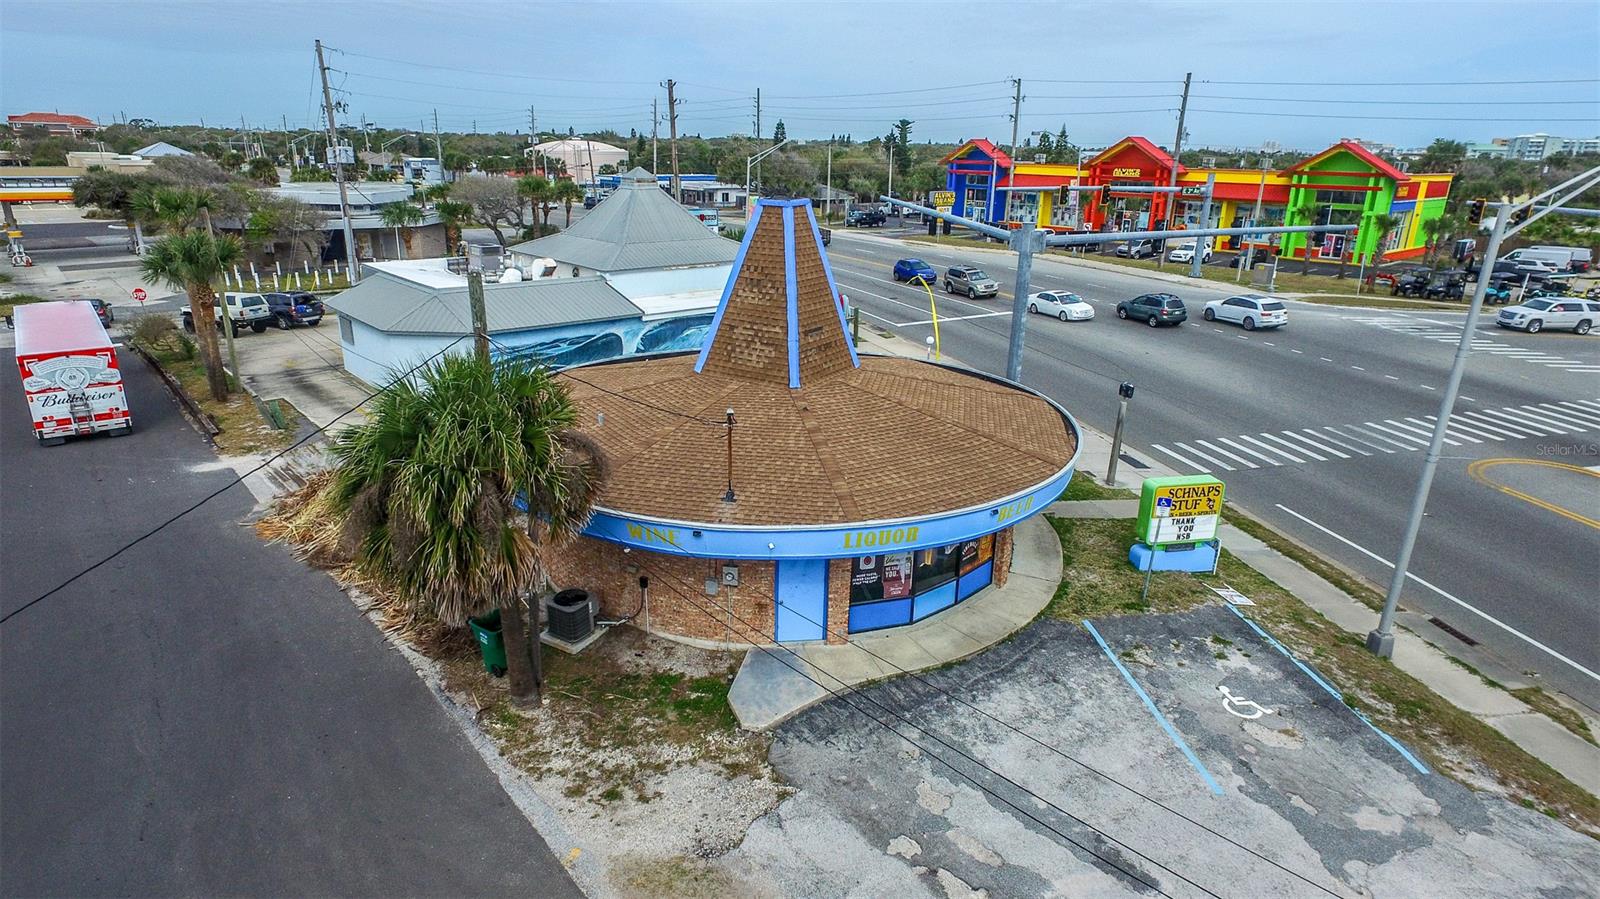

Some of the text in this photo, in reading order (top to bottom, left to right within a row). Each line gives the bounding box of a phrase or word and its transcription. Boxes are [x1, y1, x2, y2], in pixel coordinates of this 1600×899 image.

[37, 391, 115, 408] Budweiser
[1168, 486, 1221, 499] SCHNAPS
[997, 495, 1034, 522] BEER
[1171, 499, 1202, 511] STUF
[626, 522, 682, 546] WINE
[844, 527, 919, 549] LIQUOR
[1176, 532, 1191, 540] NSB
